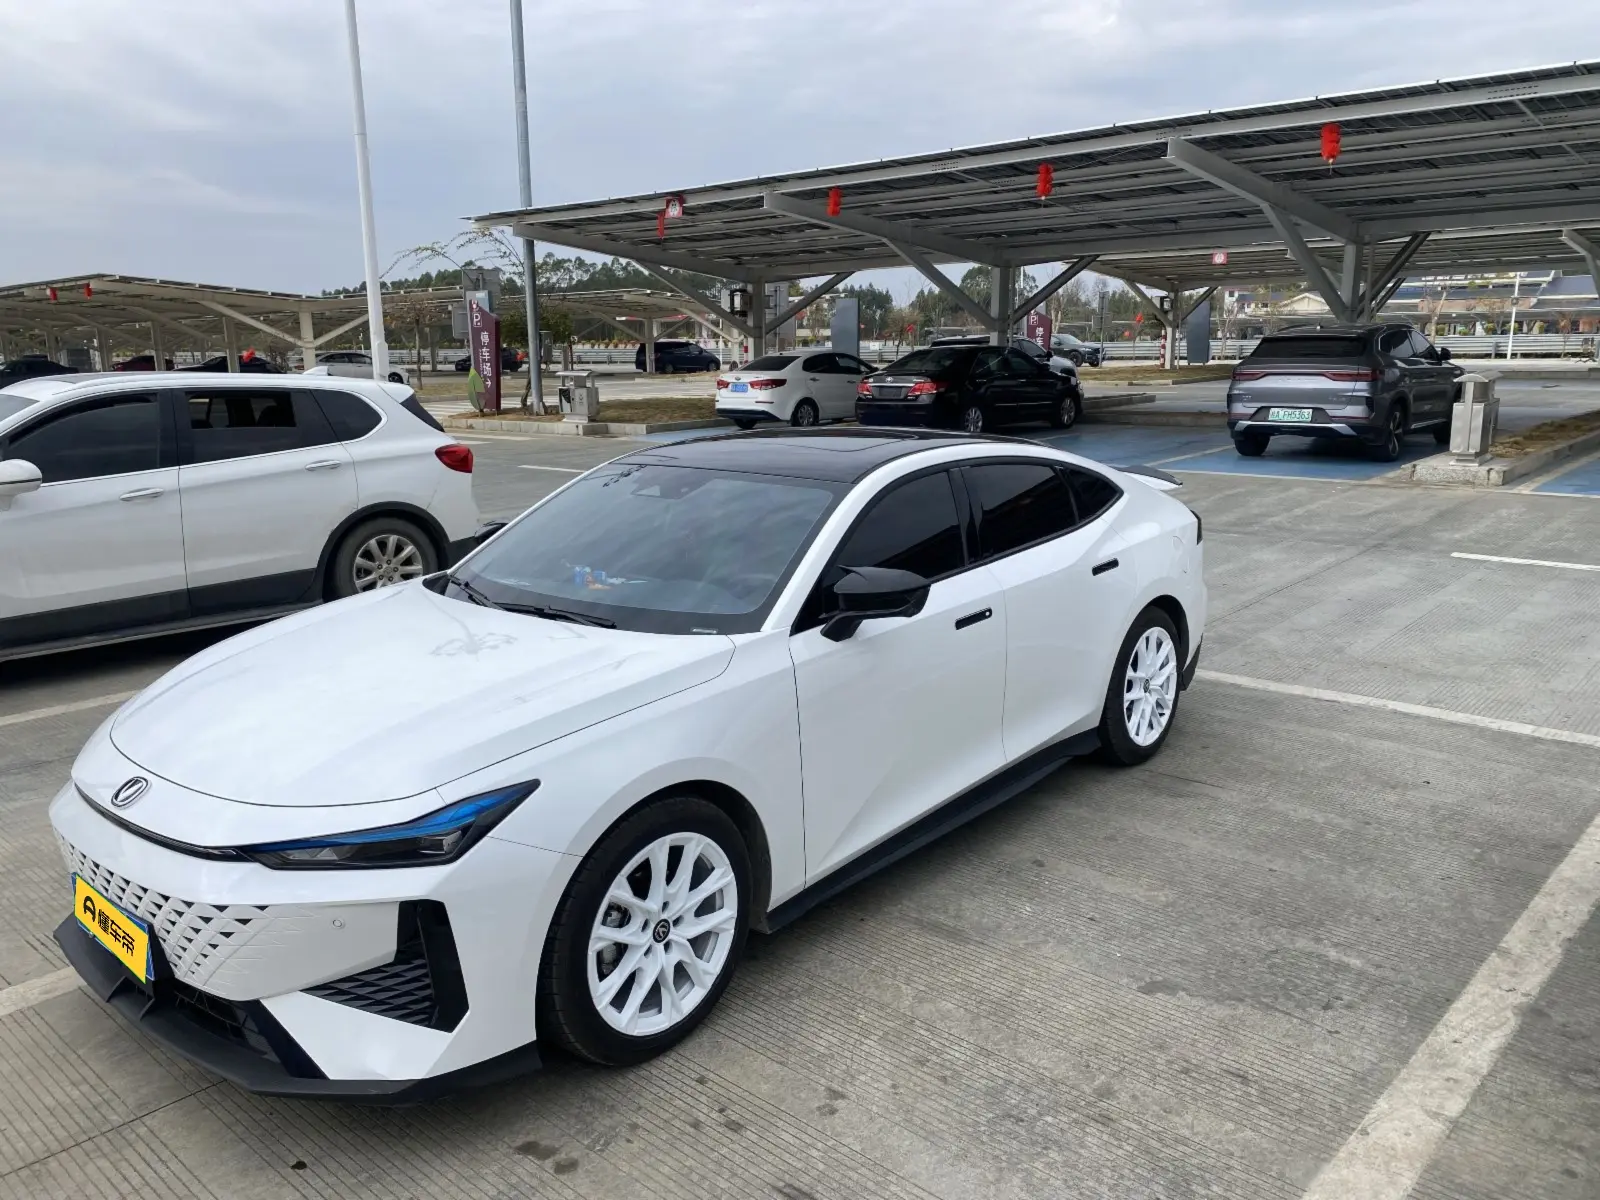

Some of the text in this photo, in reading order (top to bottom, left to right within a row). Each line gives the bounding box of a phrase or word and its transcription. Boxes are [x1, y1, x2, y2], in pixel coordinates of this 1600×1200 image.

[473, 313, 481, 326] P
[480, 331, 492, 377] 停车场
